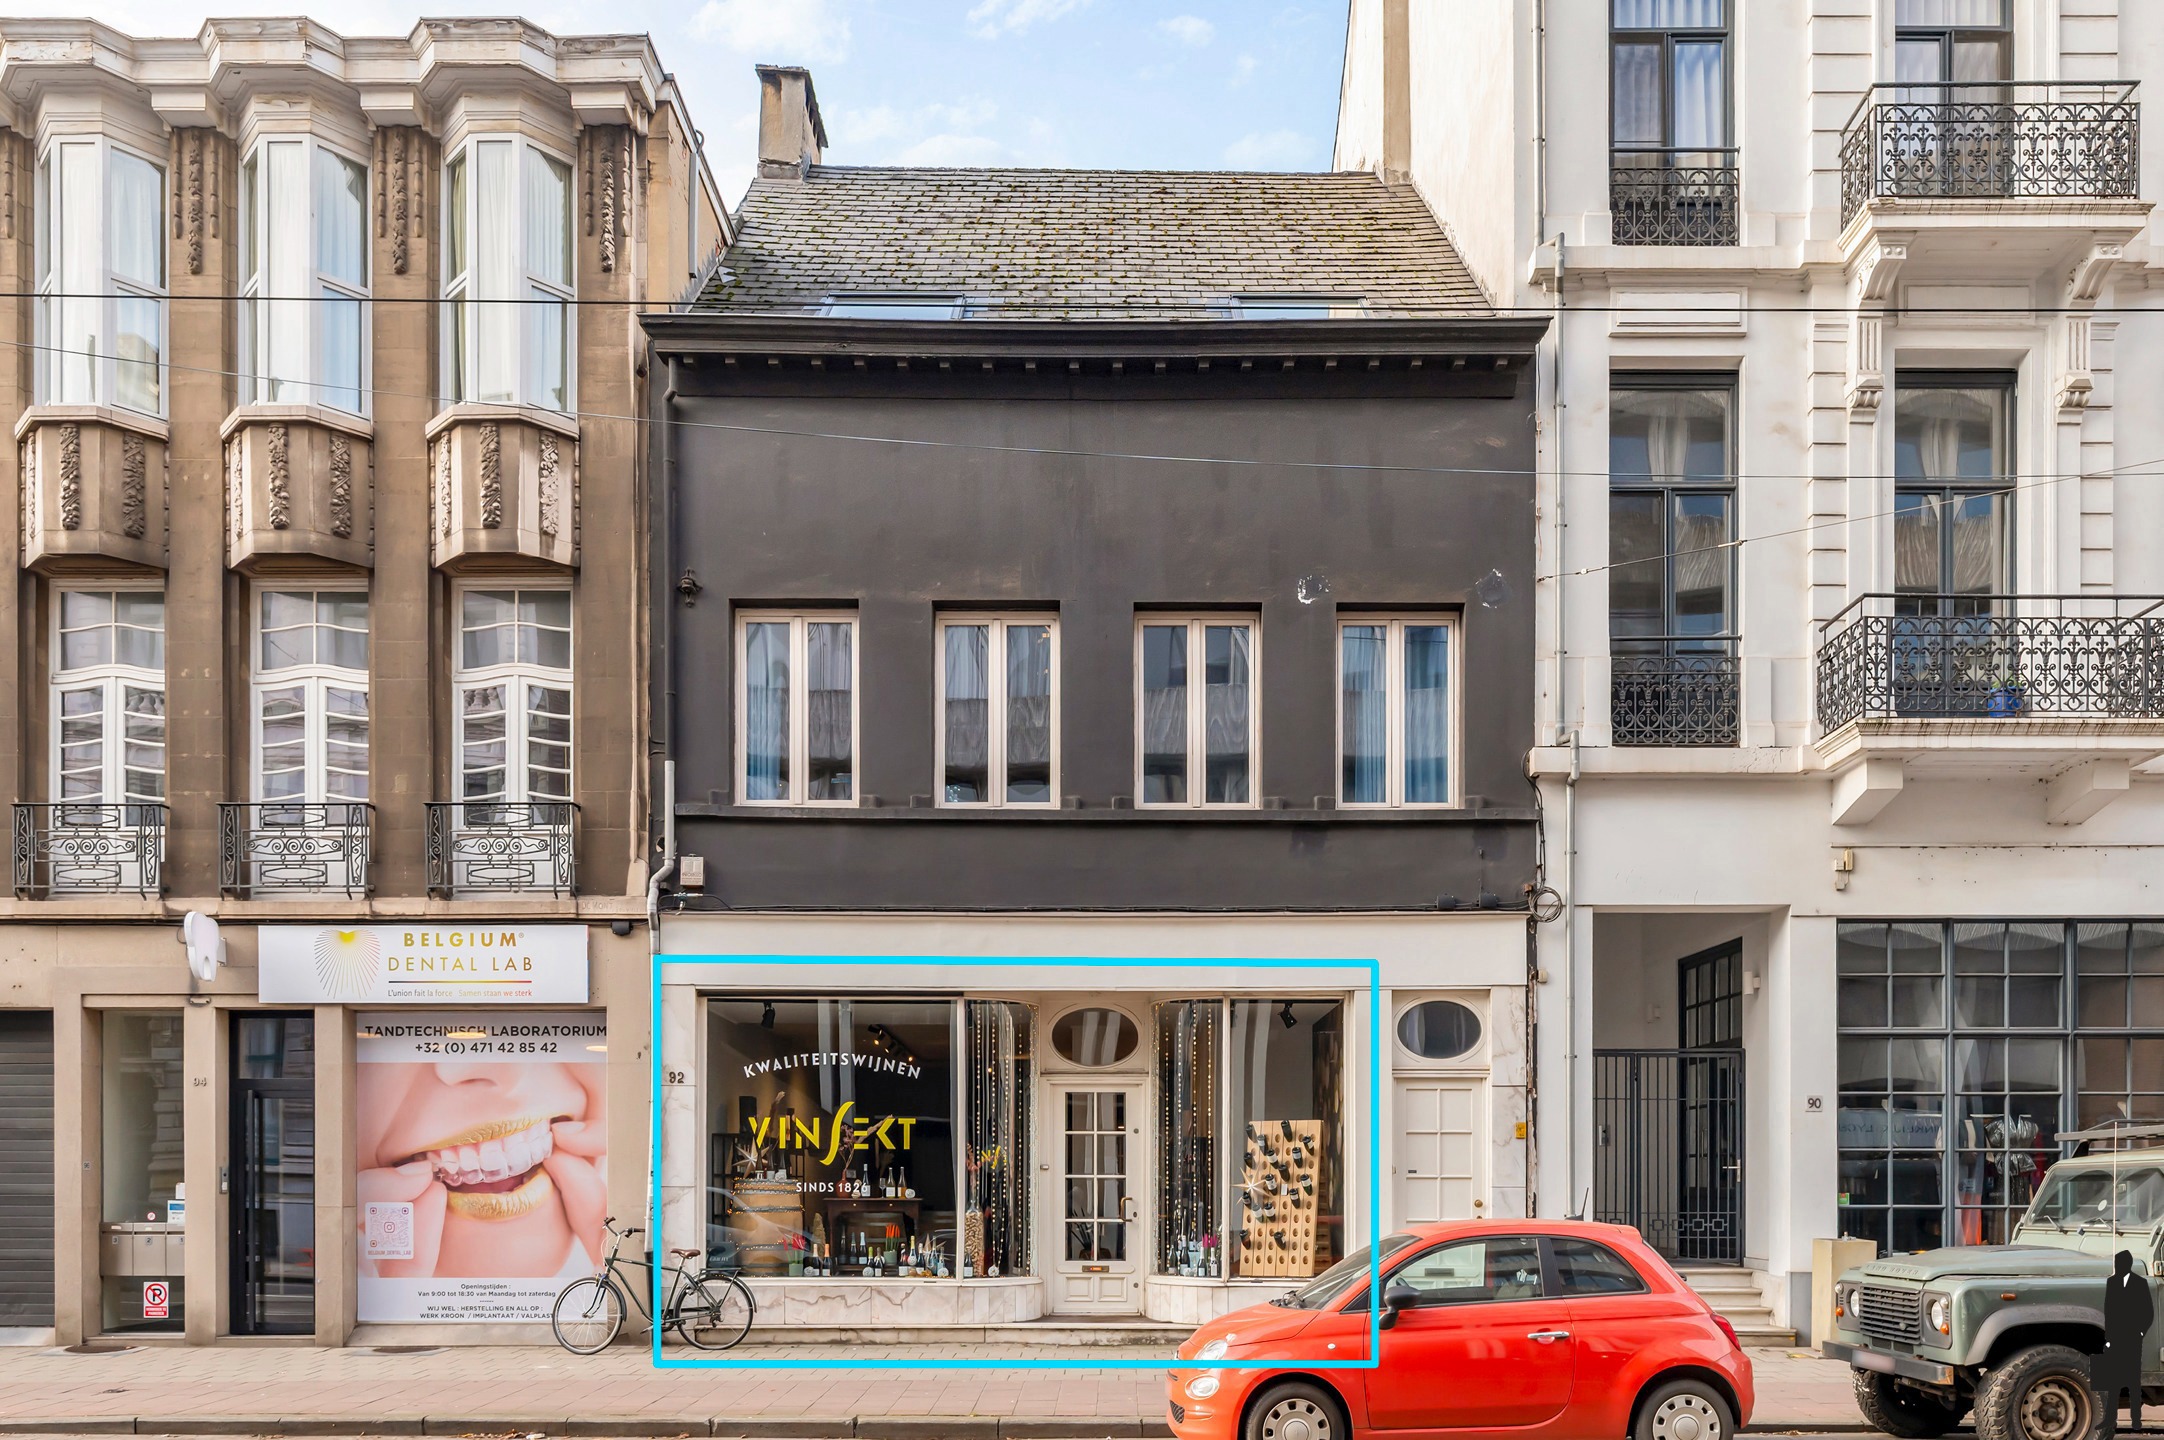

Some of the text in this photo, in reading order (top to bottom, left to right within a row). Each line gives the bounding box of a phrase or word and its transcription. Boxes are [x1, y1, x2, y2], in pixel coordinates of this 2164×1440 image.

[388, 957, 532, 971] DENTAL LAB
[414, 989, 426, 997] fait
[427, 989, 434, 997] la
[435, 989, 453, 997] force
[458, 989, 481, 997] Samen
[483, 989, 502, 997] staan
[515, 989, 533, 997] sterk
[365, 1026, 607, 1037] TANDTECHNISCH LABORATORIUM
[415, 1042, 558, 1055] +32 (0) 471 42 85 42
[743, 1052, 921, 1080] KWALITEITSWIJNEN
[193, 1077, 208, 1087] 94
[668, 1071, 685, 1084] 92
[1807, 1097, 1822, 1109] 90
[747, 1101, 917, 1166] VINSEKT
[795, 1182, 868, 1193] SINDS 1826
